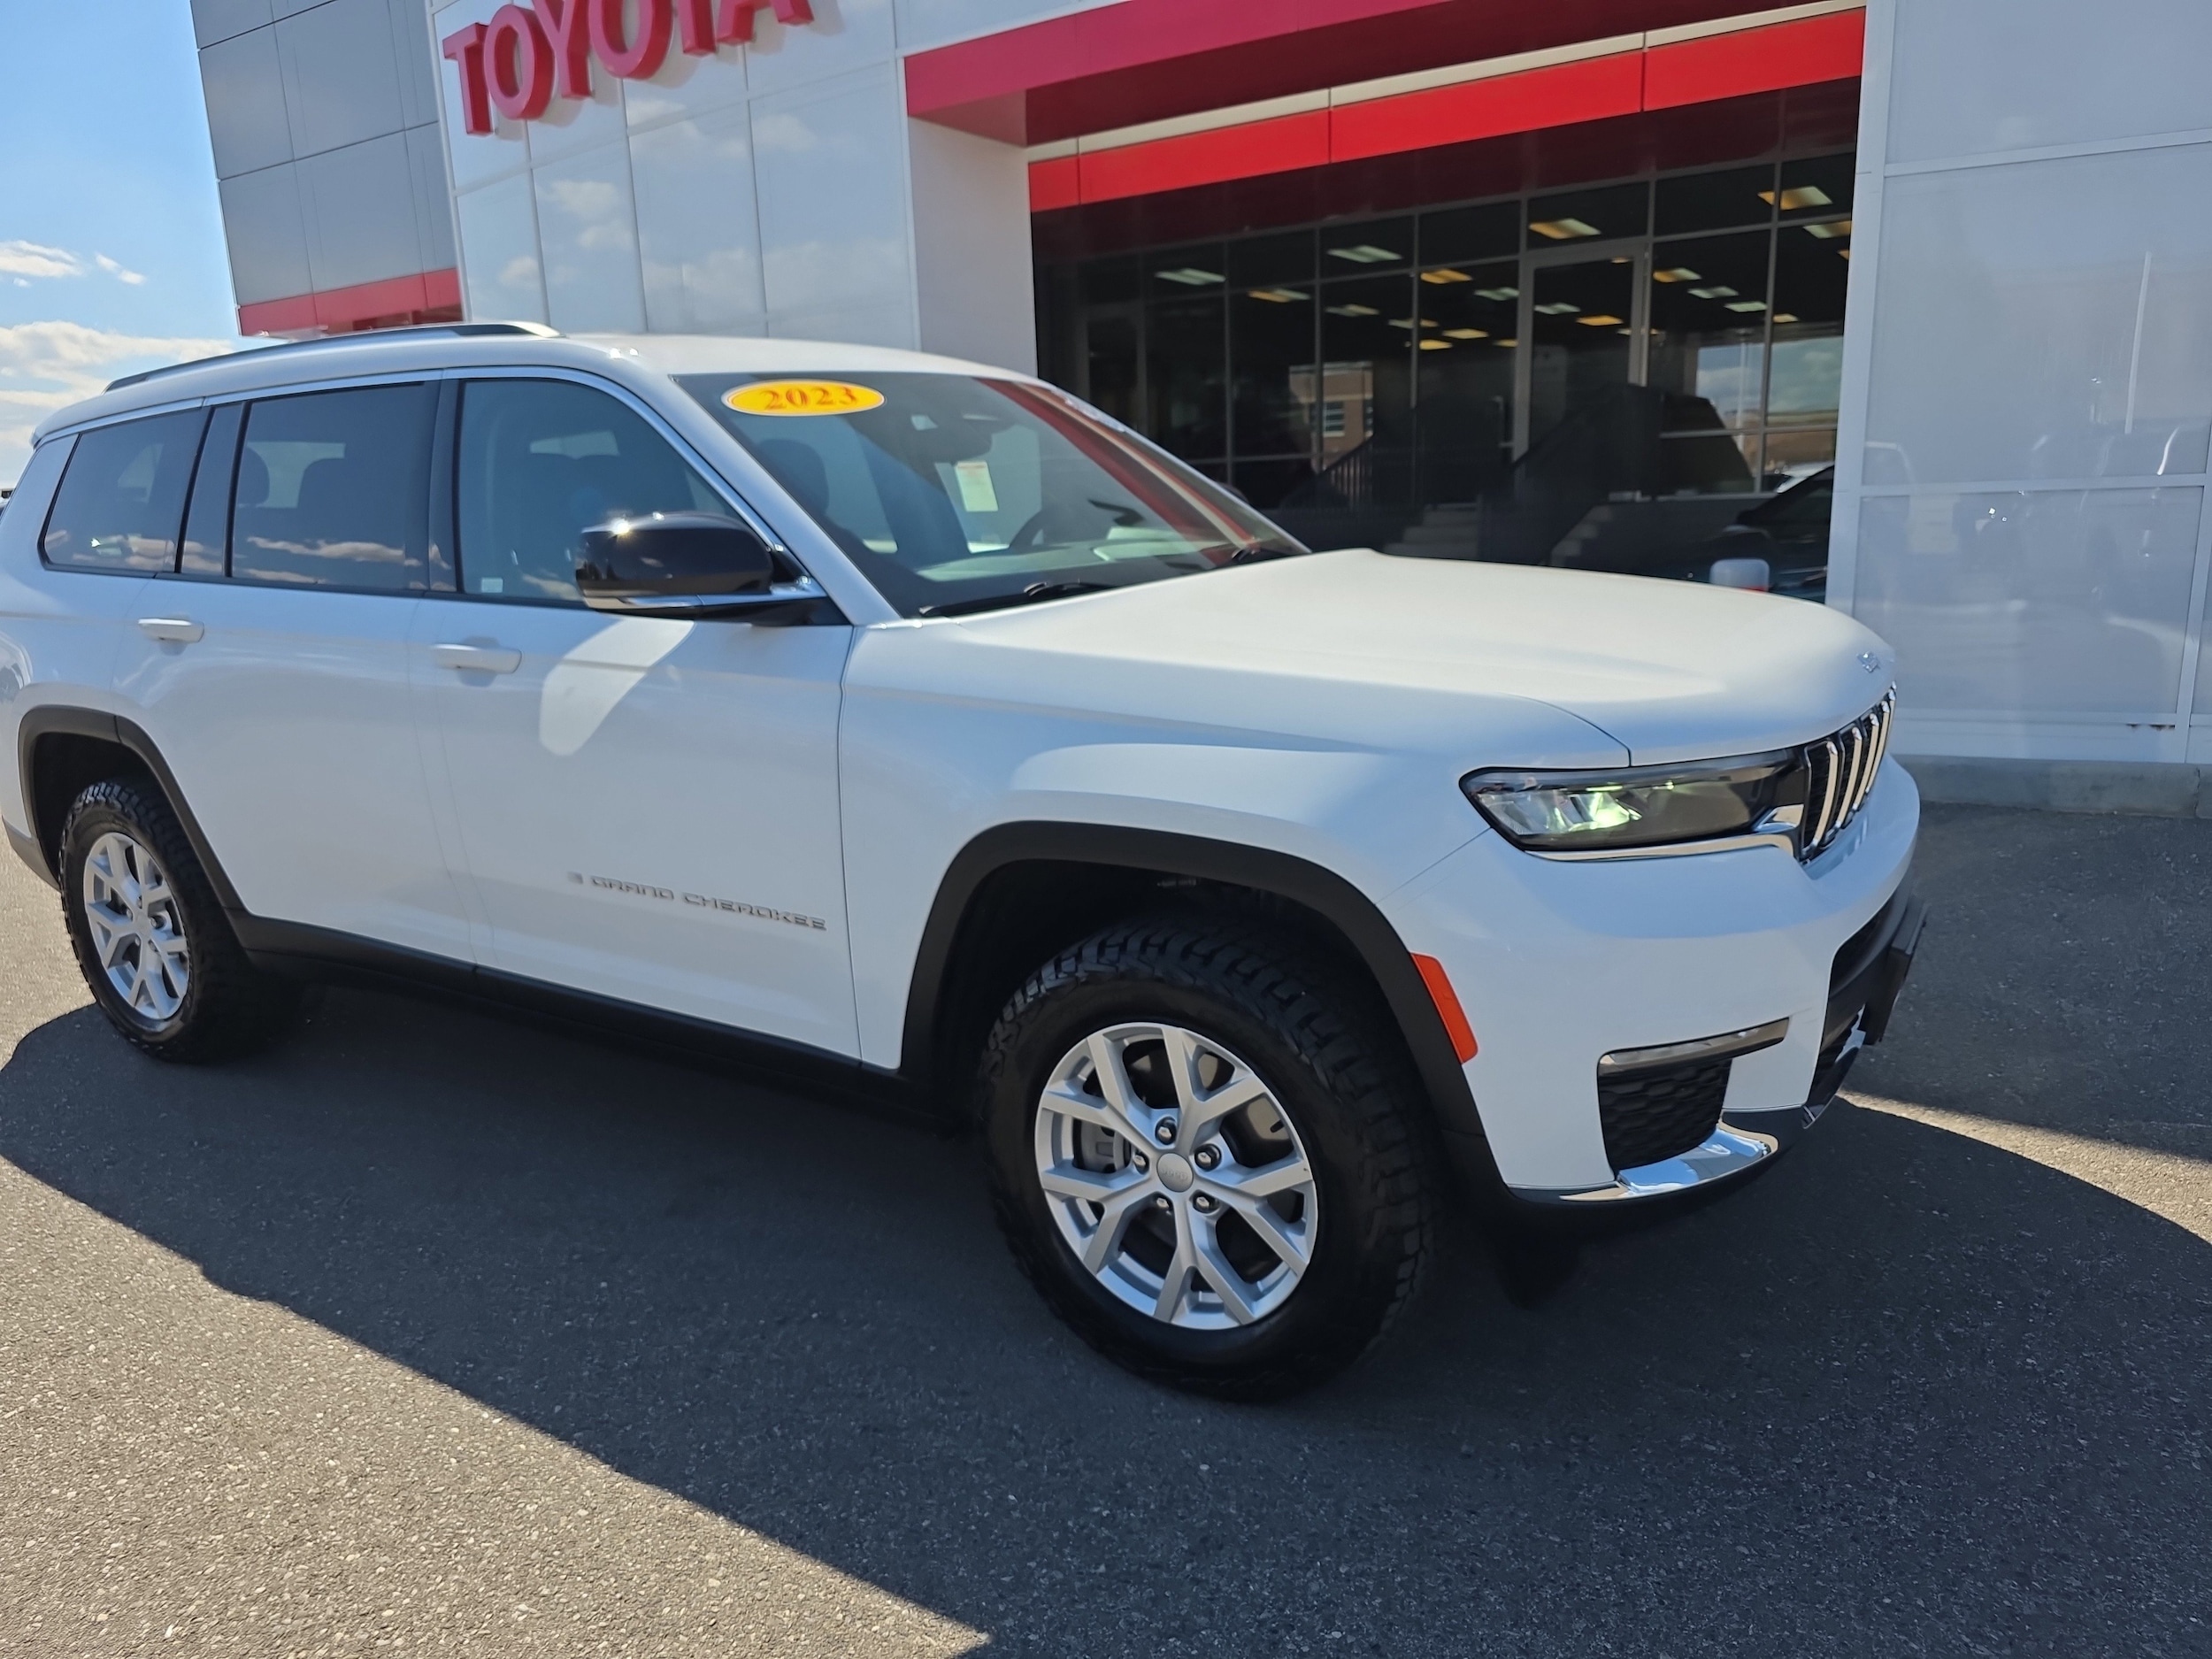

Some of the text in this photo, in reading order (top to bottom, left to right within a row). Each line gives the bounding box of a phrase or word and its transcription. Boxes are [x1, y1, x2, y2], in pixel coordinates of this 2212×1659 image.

[760, 386, 857, 411] 2023
[591, 875, 827, 931] GRAND CHEROKEE
